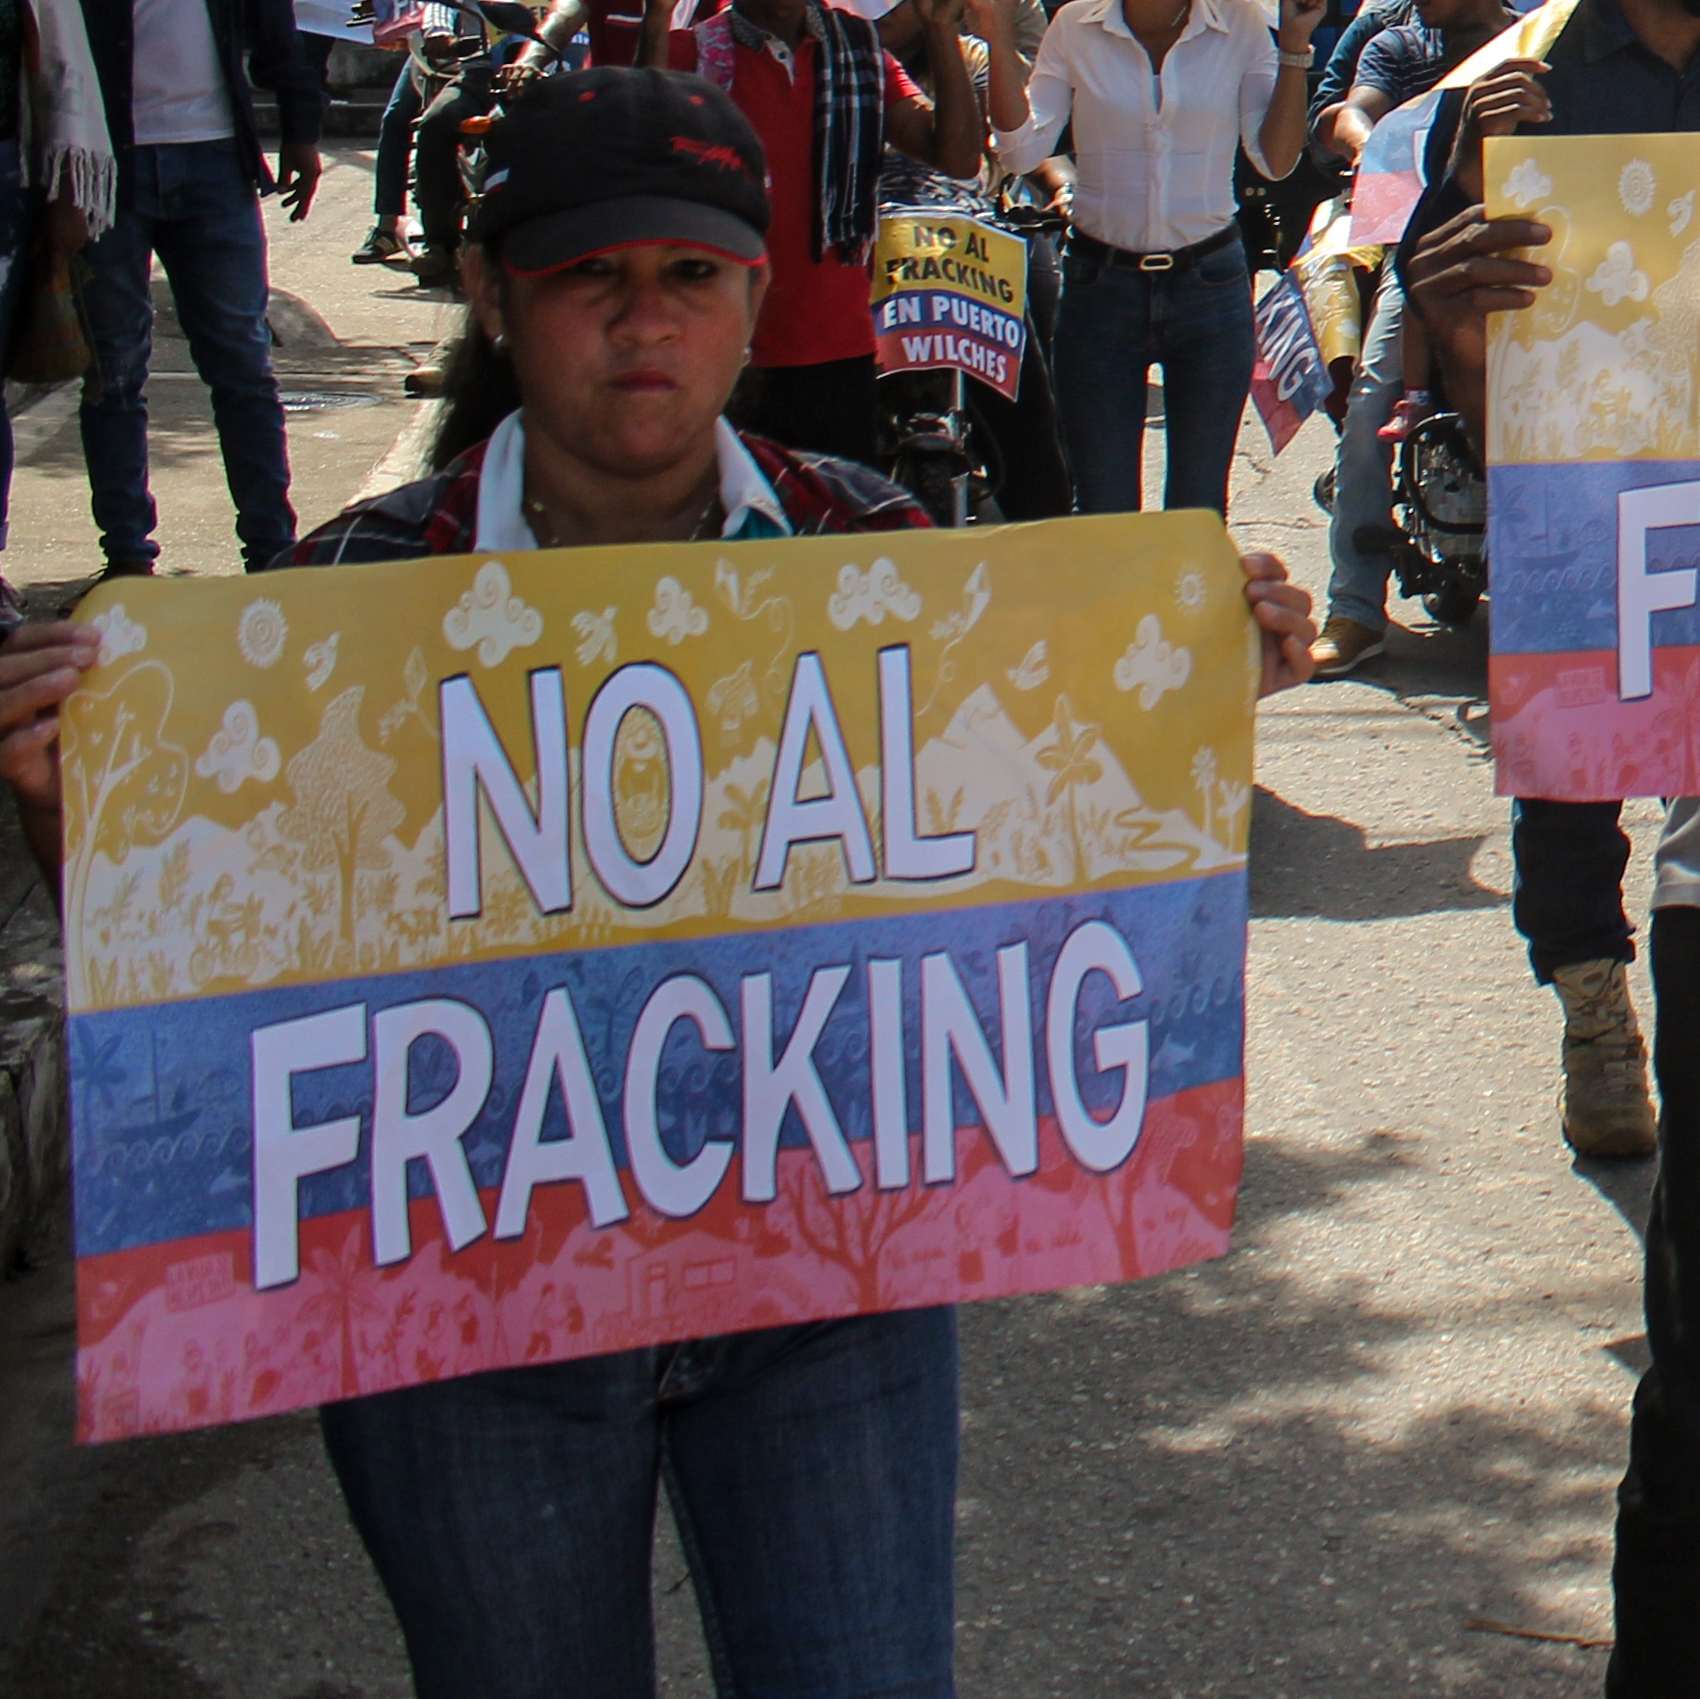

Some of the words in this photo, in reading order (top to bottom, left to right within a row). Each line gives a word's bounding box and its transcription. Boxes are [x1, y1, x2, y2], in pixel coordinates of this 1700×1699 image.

[914, 226, 956, 249] NO
[964, 232, 989, 262] AL
[886, 256, 1014, 303] FRACKING
[884, 296, 921, 329] EN
[932, 295, 1020, 349] PUERTO
[901, 333, 1007, 383] WILCHES
[438, 659, 704, 920] NO
[753, 644, 977, 891] AL
[250, 921, 1151, 1291] FRACKING
